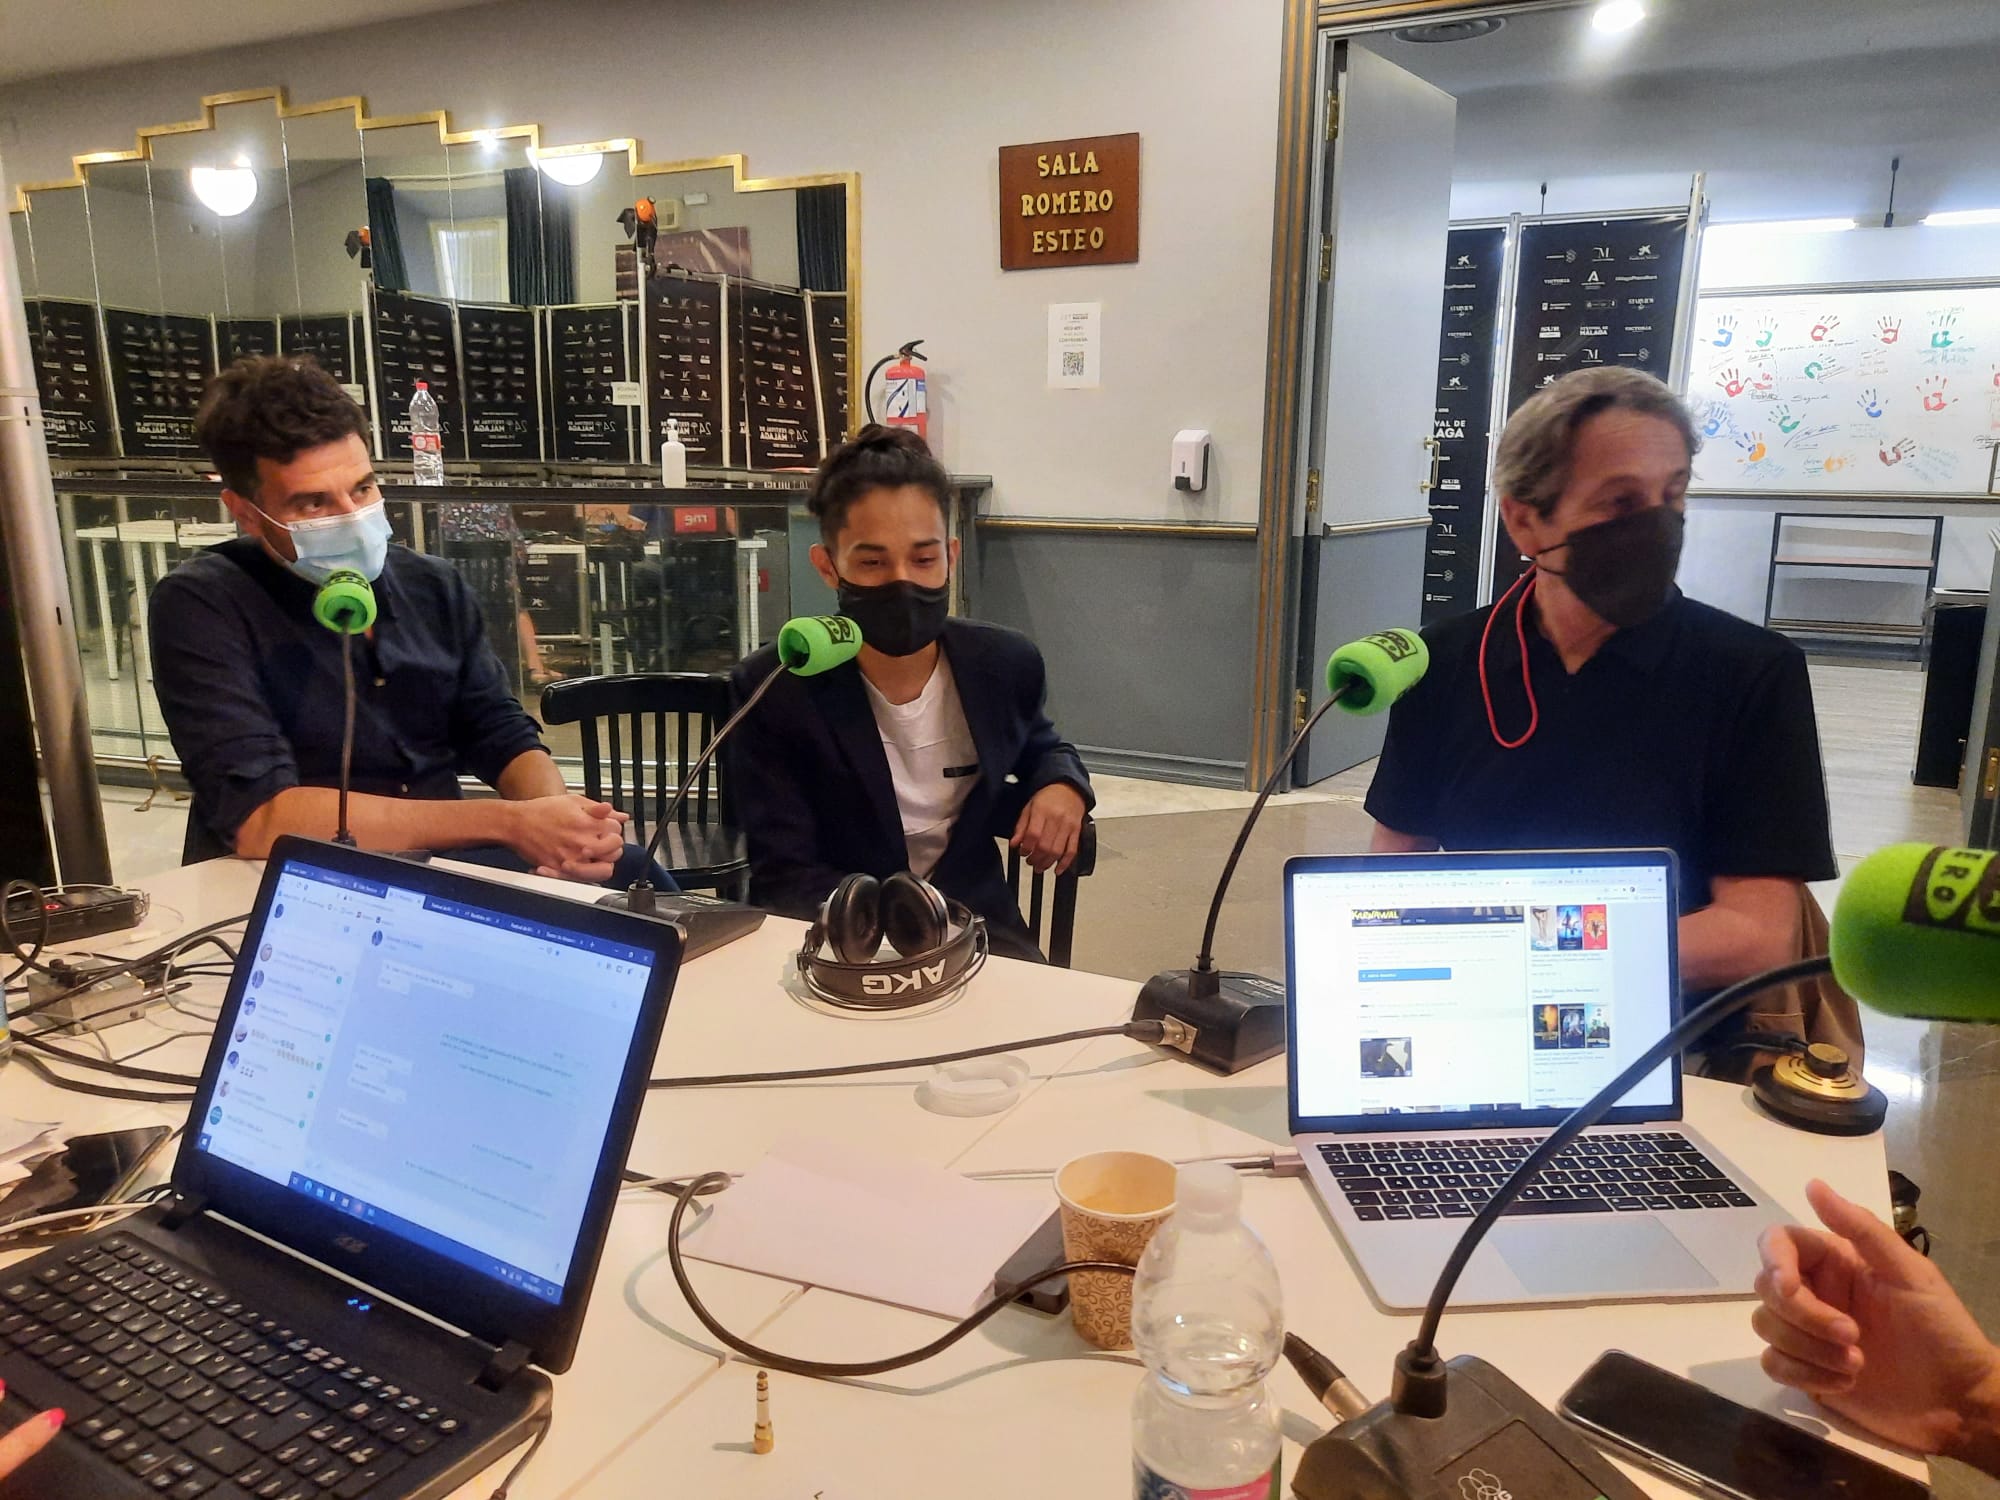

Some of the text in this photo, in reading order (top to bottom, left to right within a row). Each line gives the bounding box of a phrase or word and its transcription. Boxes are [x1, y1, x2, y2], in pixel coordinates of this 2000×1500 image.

[1037, 151, 1100, 177] SALA
[1021, 189, 1114, 217] ROMERO
[1032, 226, 1105, 253] ESTEO
[862, 958, 947, 995] AKG
